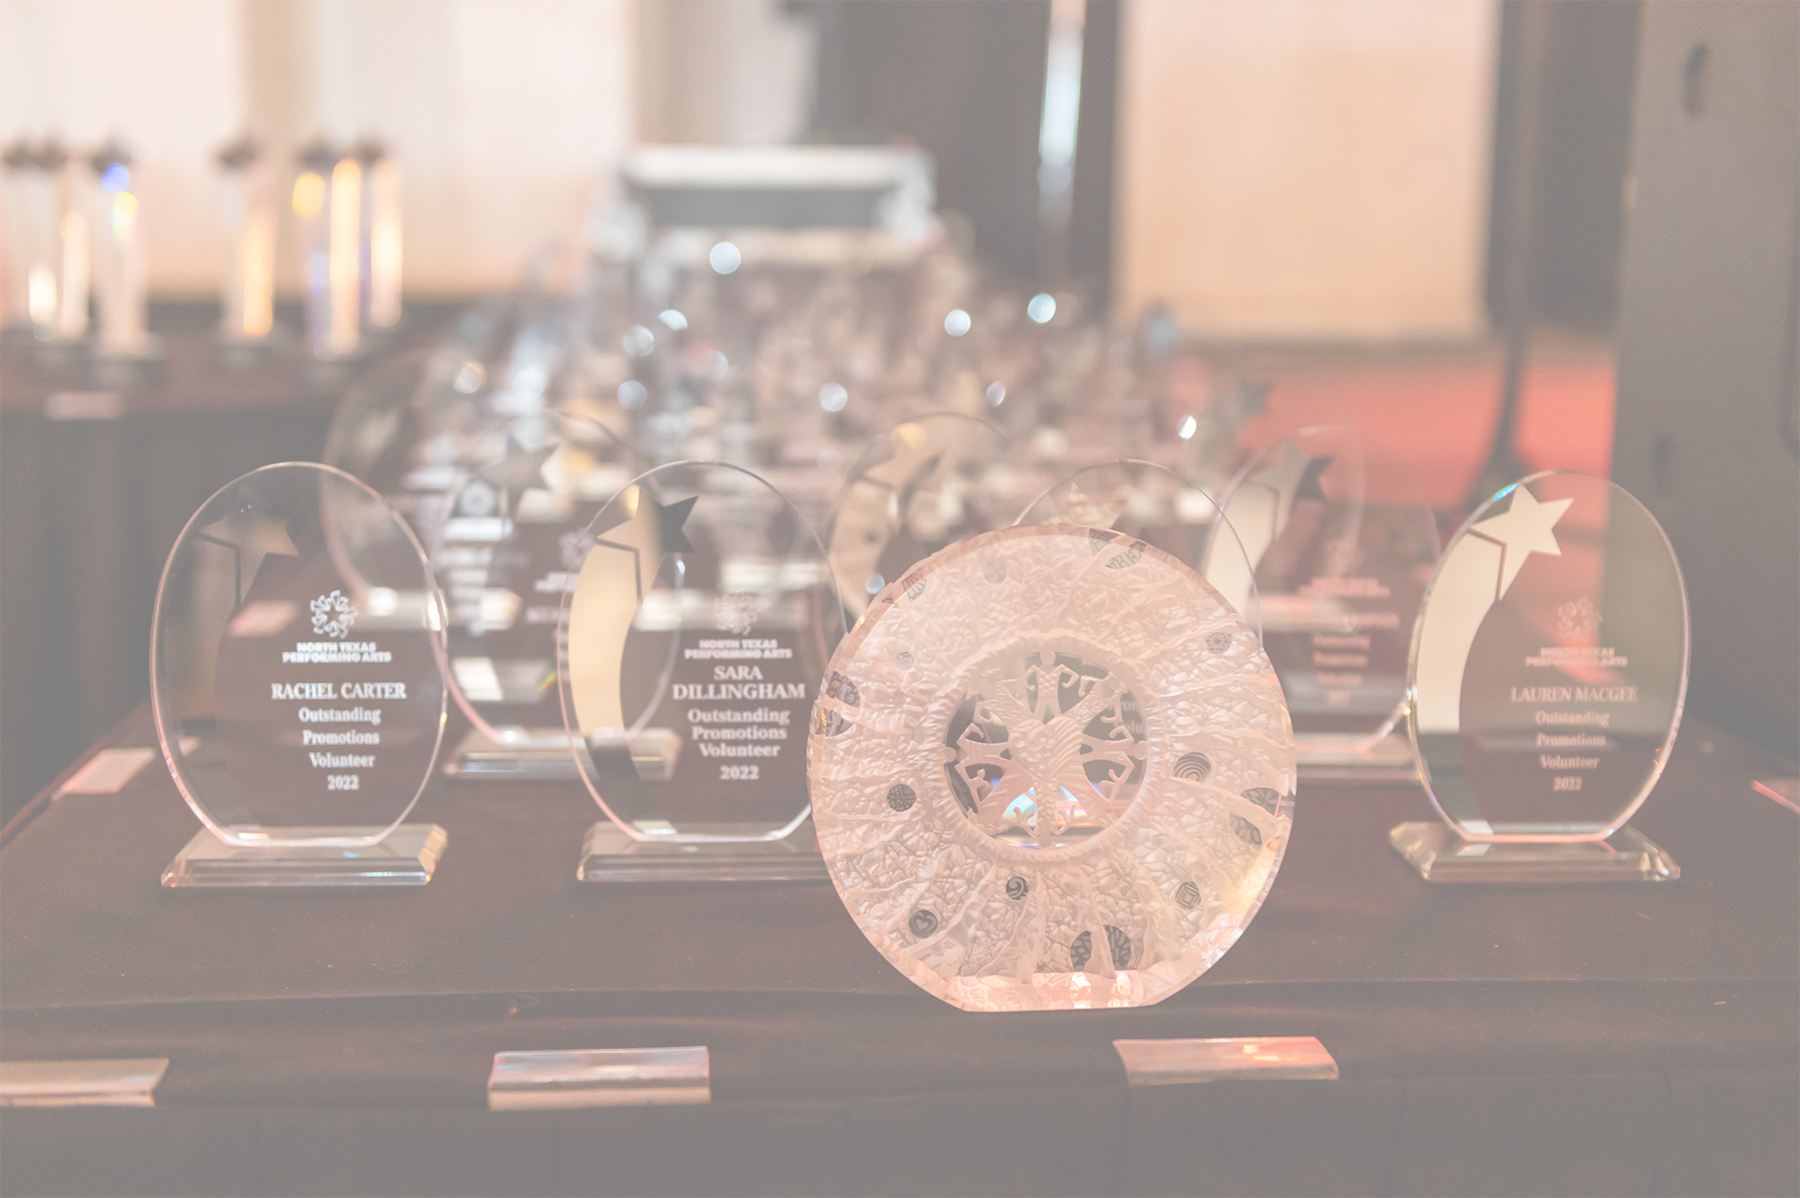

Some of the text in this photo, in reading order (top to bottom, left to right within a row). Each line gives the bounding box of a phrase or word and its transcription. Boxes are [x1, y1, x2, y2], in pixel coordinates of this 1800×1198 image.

[297, 641, 377, 652] NORTH TEXAS
[699, 639, 778, 649] NORTH TEXAS
[282, 652, 392, 663] PERFORMING ARTS
[684, 649, 793, 659] PERFORMING ARTS
[713, 665, 764, 681] SARA
[271, 682, 407, 700] RACHEL CARTER
[672, 683, 807, 700] DILLINGHAM
[1510, 686, 1639, 703] LAUREN MACGEE
[298, 707, 382, 726] Outstanding
[687, 708, 791, 725] Outstanding
[1535, 711, 1610, 727] Outstanding
[302, 730, 380, 745] Promotions
[691, 726, 788, 740] Promotions
[1536, 732, 1606, 747] Promotions
[698, 743, 781, 758] Volunteer
[309, 752, 375, 768] Volunteer
[1540, 755, 1600, 769] Volunteer
[719, 765, 760, 780] 2022
[327, 775, 359, 790] 2022
[1553, 776, 1582, 791] 2022
